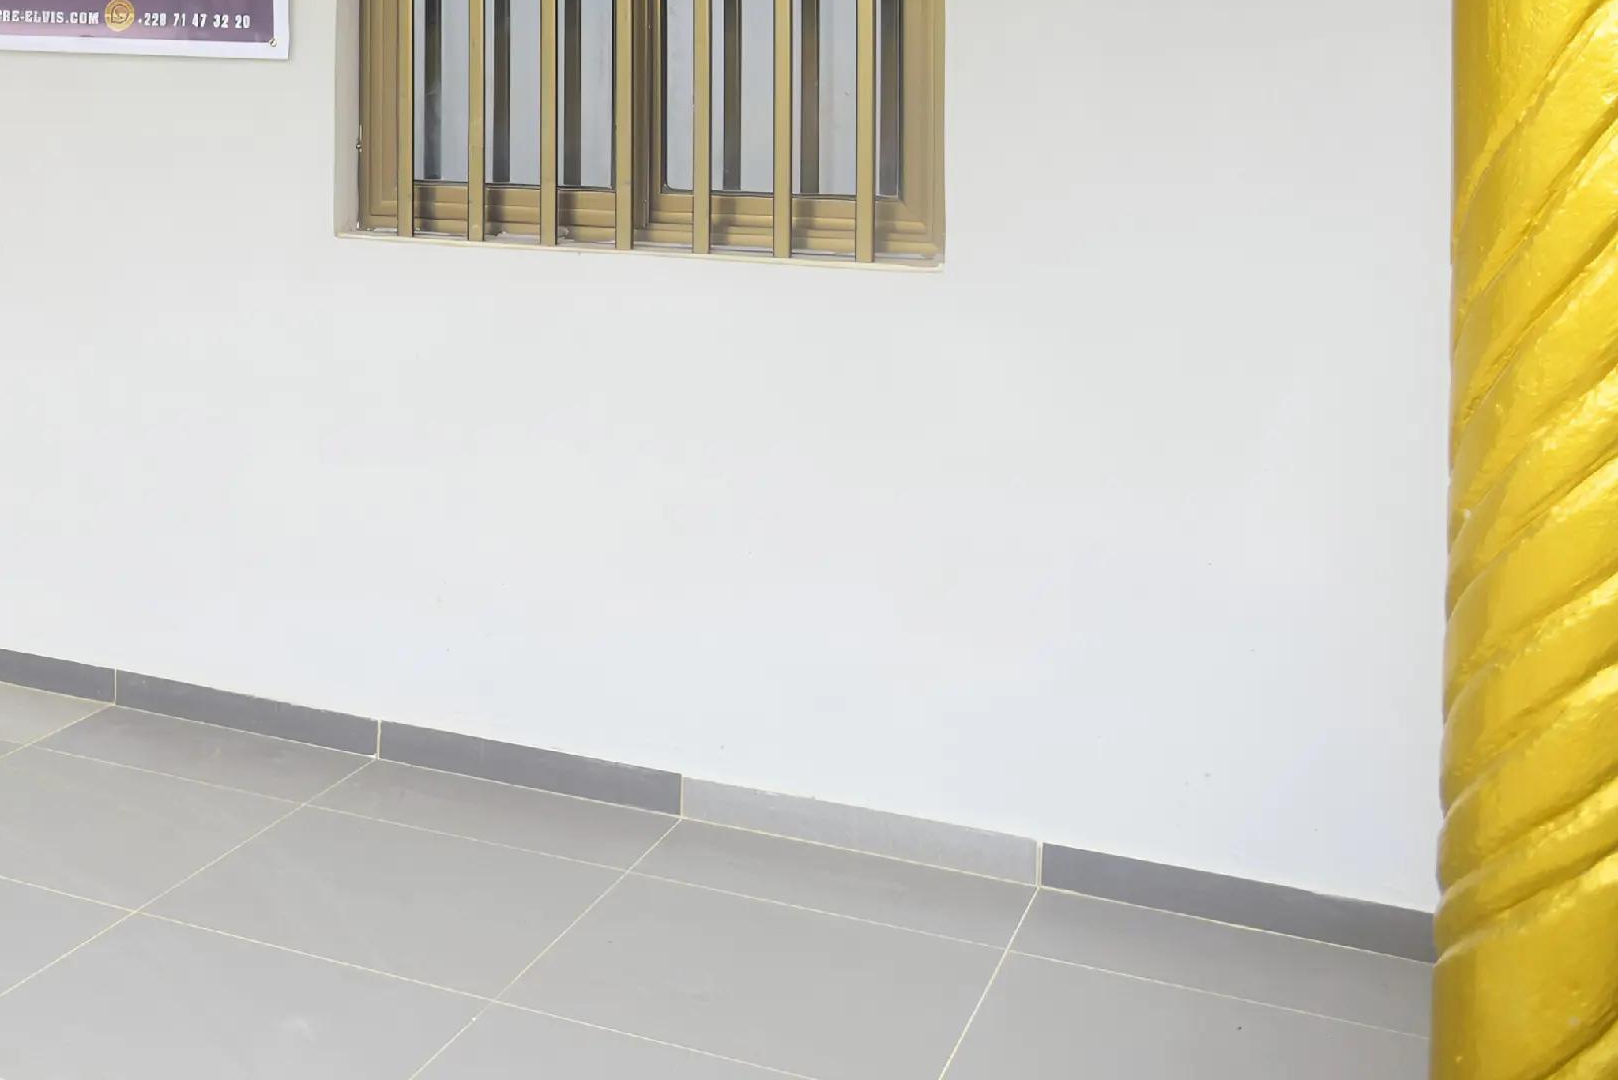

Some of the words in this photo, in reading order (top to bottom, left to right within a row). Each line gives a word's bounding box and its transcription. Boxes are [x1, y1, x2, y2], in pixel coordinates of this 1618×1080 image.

[173, 13, 186, 27] 71
[192, 13, 207, 28] 47
[213, 14, 229, 29] 32
[235, 15, 251, 29] 20
